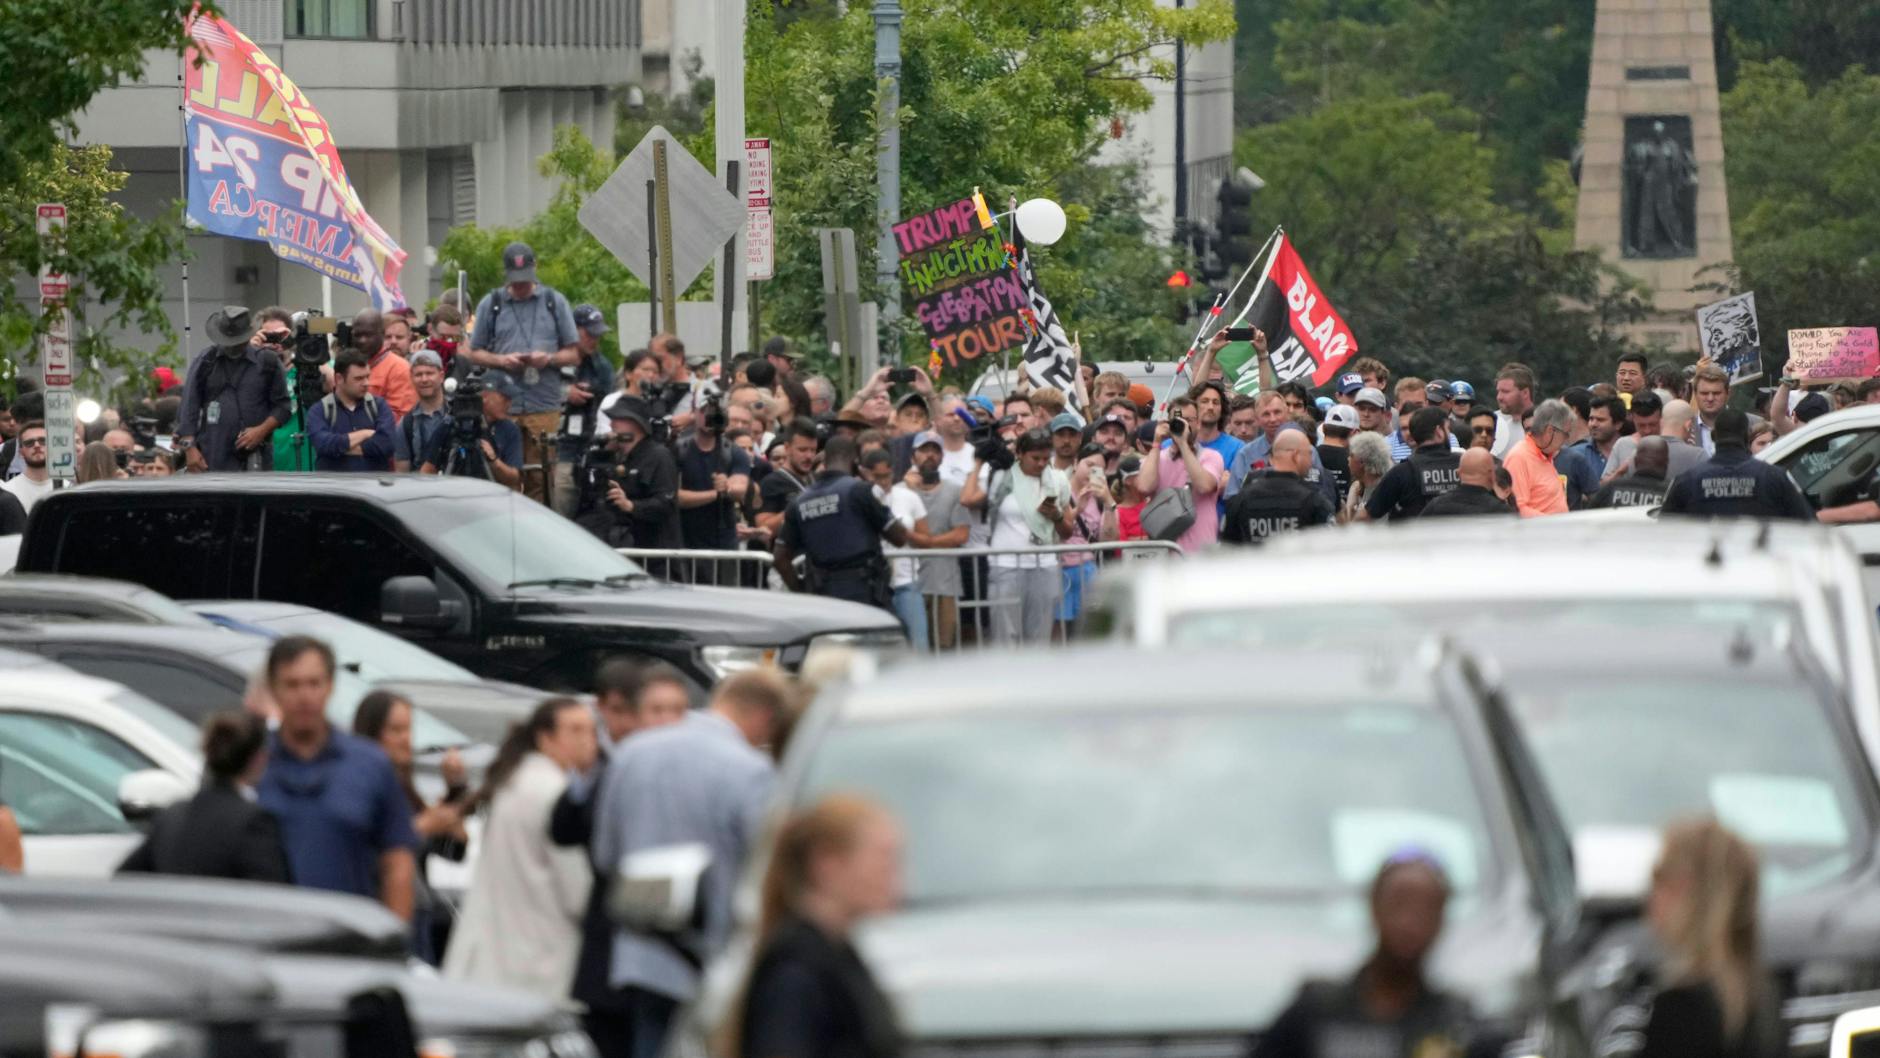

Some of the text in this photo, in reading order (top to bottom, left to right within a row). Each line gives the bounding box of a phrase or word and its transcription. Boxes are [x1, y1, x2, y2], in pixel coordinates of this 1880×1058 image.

[748, 151, 758, 159] NO
[892, 199, 976, 252] TRUMP
[937, 316, 1024, 368] TOUR
[1829, 349, 1840, 357] to
[1846, 348, 1864, 358] the
[1423, 469, 1460, 484] POLIC
[1613, 490, 1662, 506] POLICE
[1704, 487, 1753, 498] POLICE
[1250, 517, 1298, 537] POLICE
